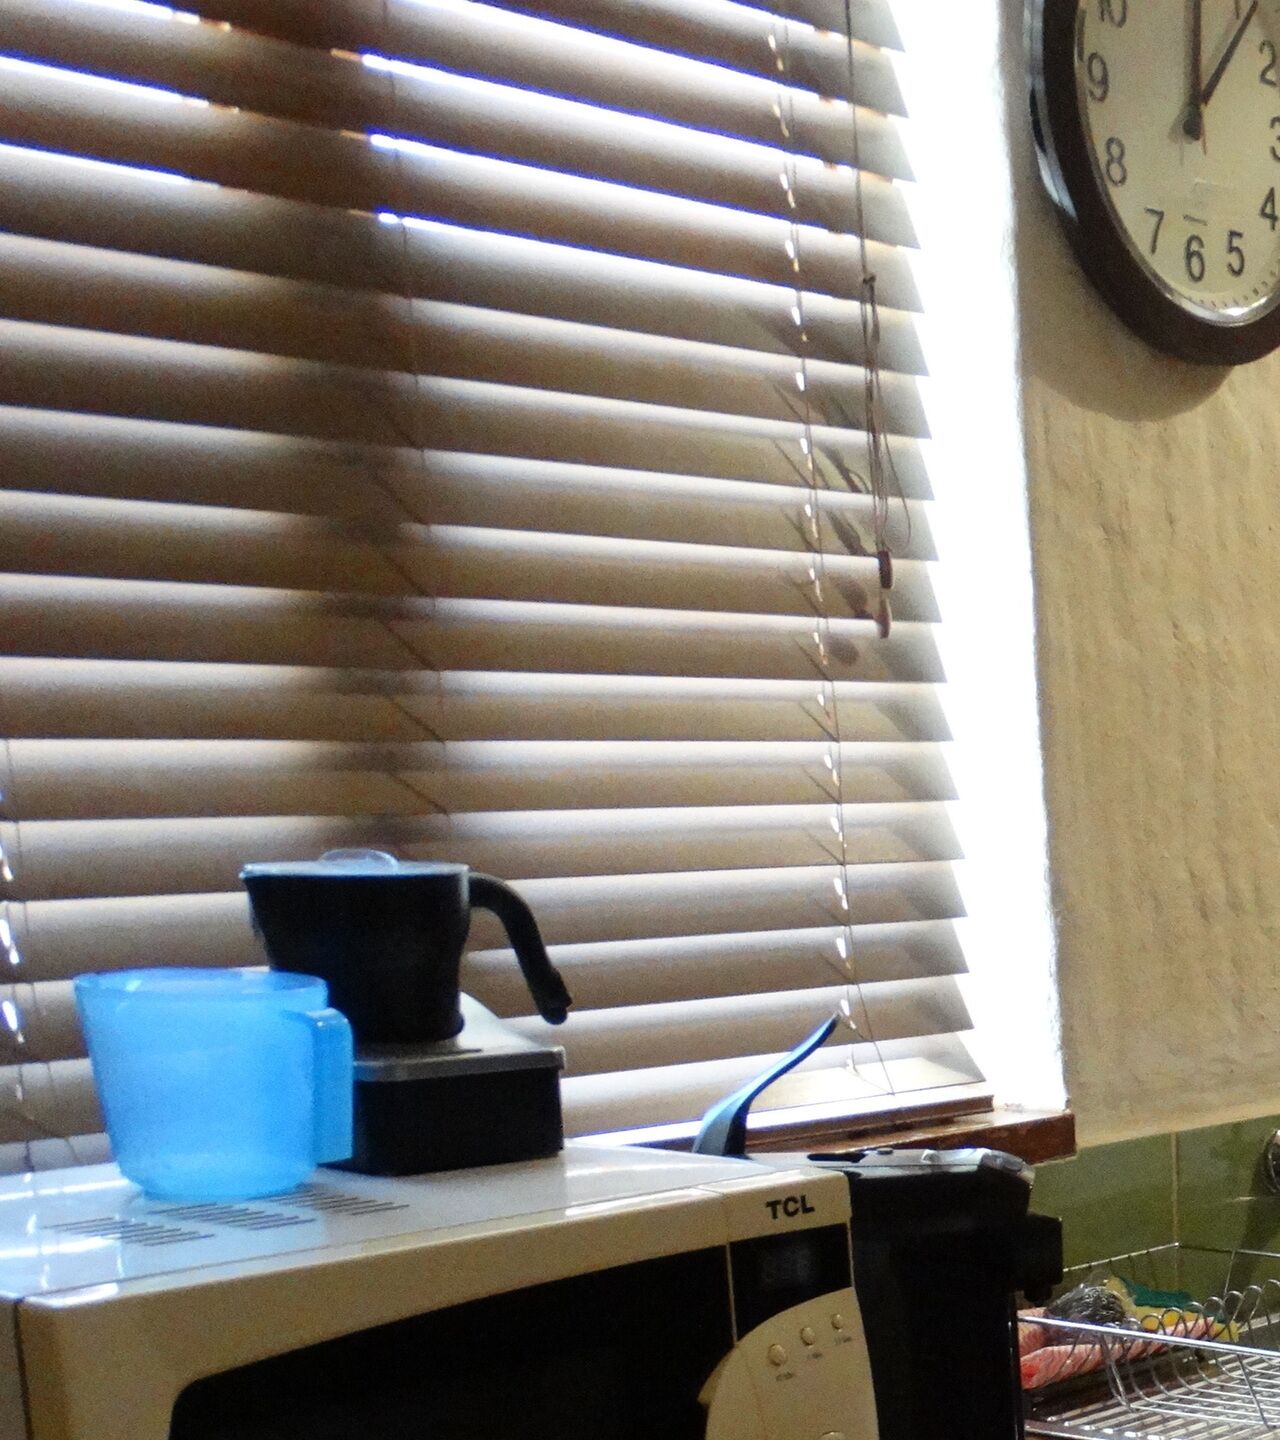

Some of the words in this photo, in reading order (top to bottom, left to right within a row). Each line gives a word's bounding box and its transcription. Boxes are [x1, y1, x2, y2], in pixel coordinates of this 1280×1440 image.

[1087, 52, 1109, 103] 9
[1258, 39, 1279, 87] 2
[1104, 136, 1127, 187] 8
[1145, 207, 1164, 254] 7
[1259, 187, 1278, 232] 4
[1184, 235, 1205, 283] 6
[1226, 230, 1244, 277] 5
[765, 1194, 815, 1220] TCL
